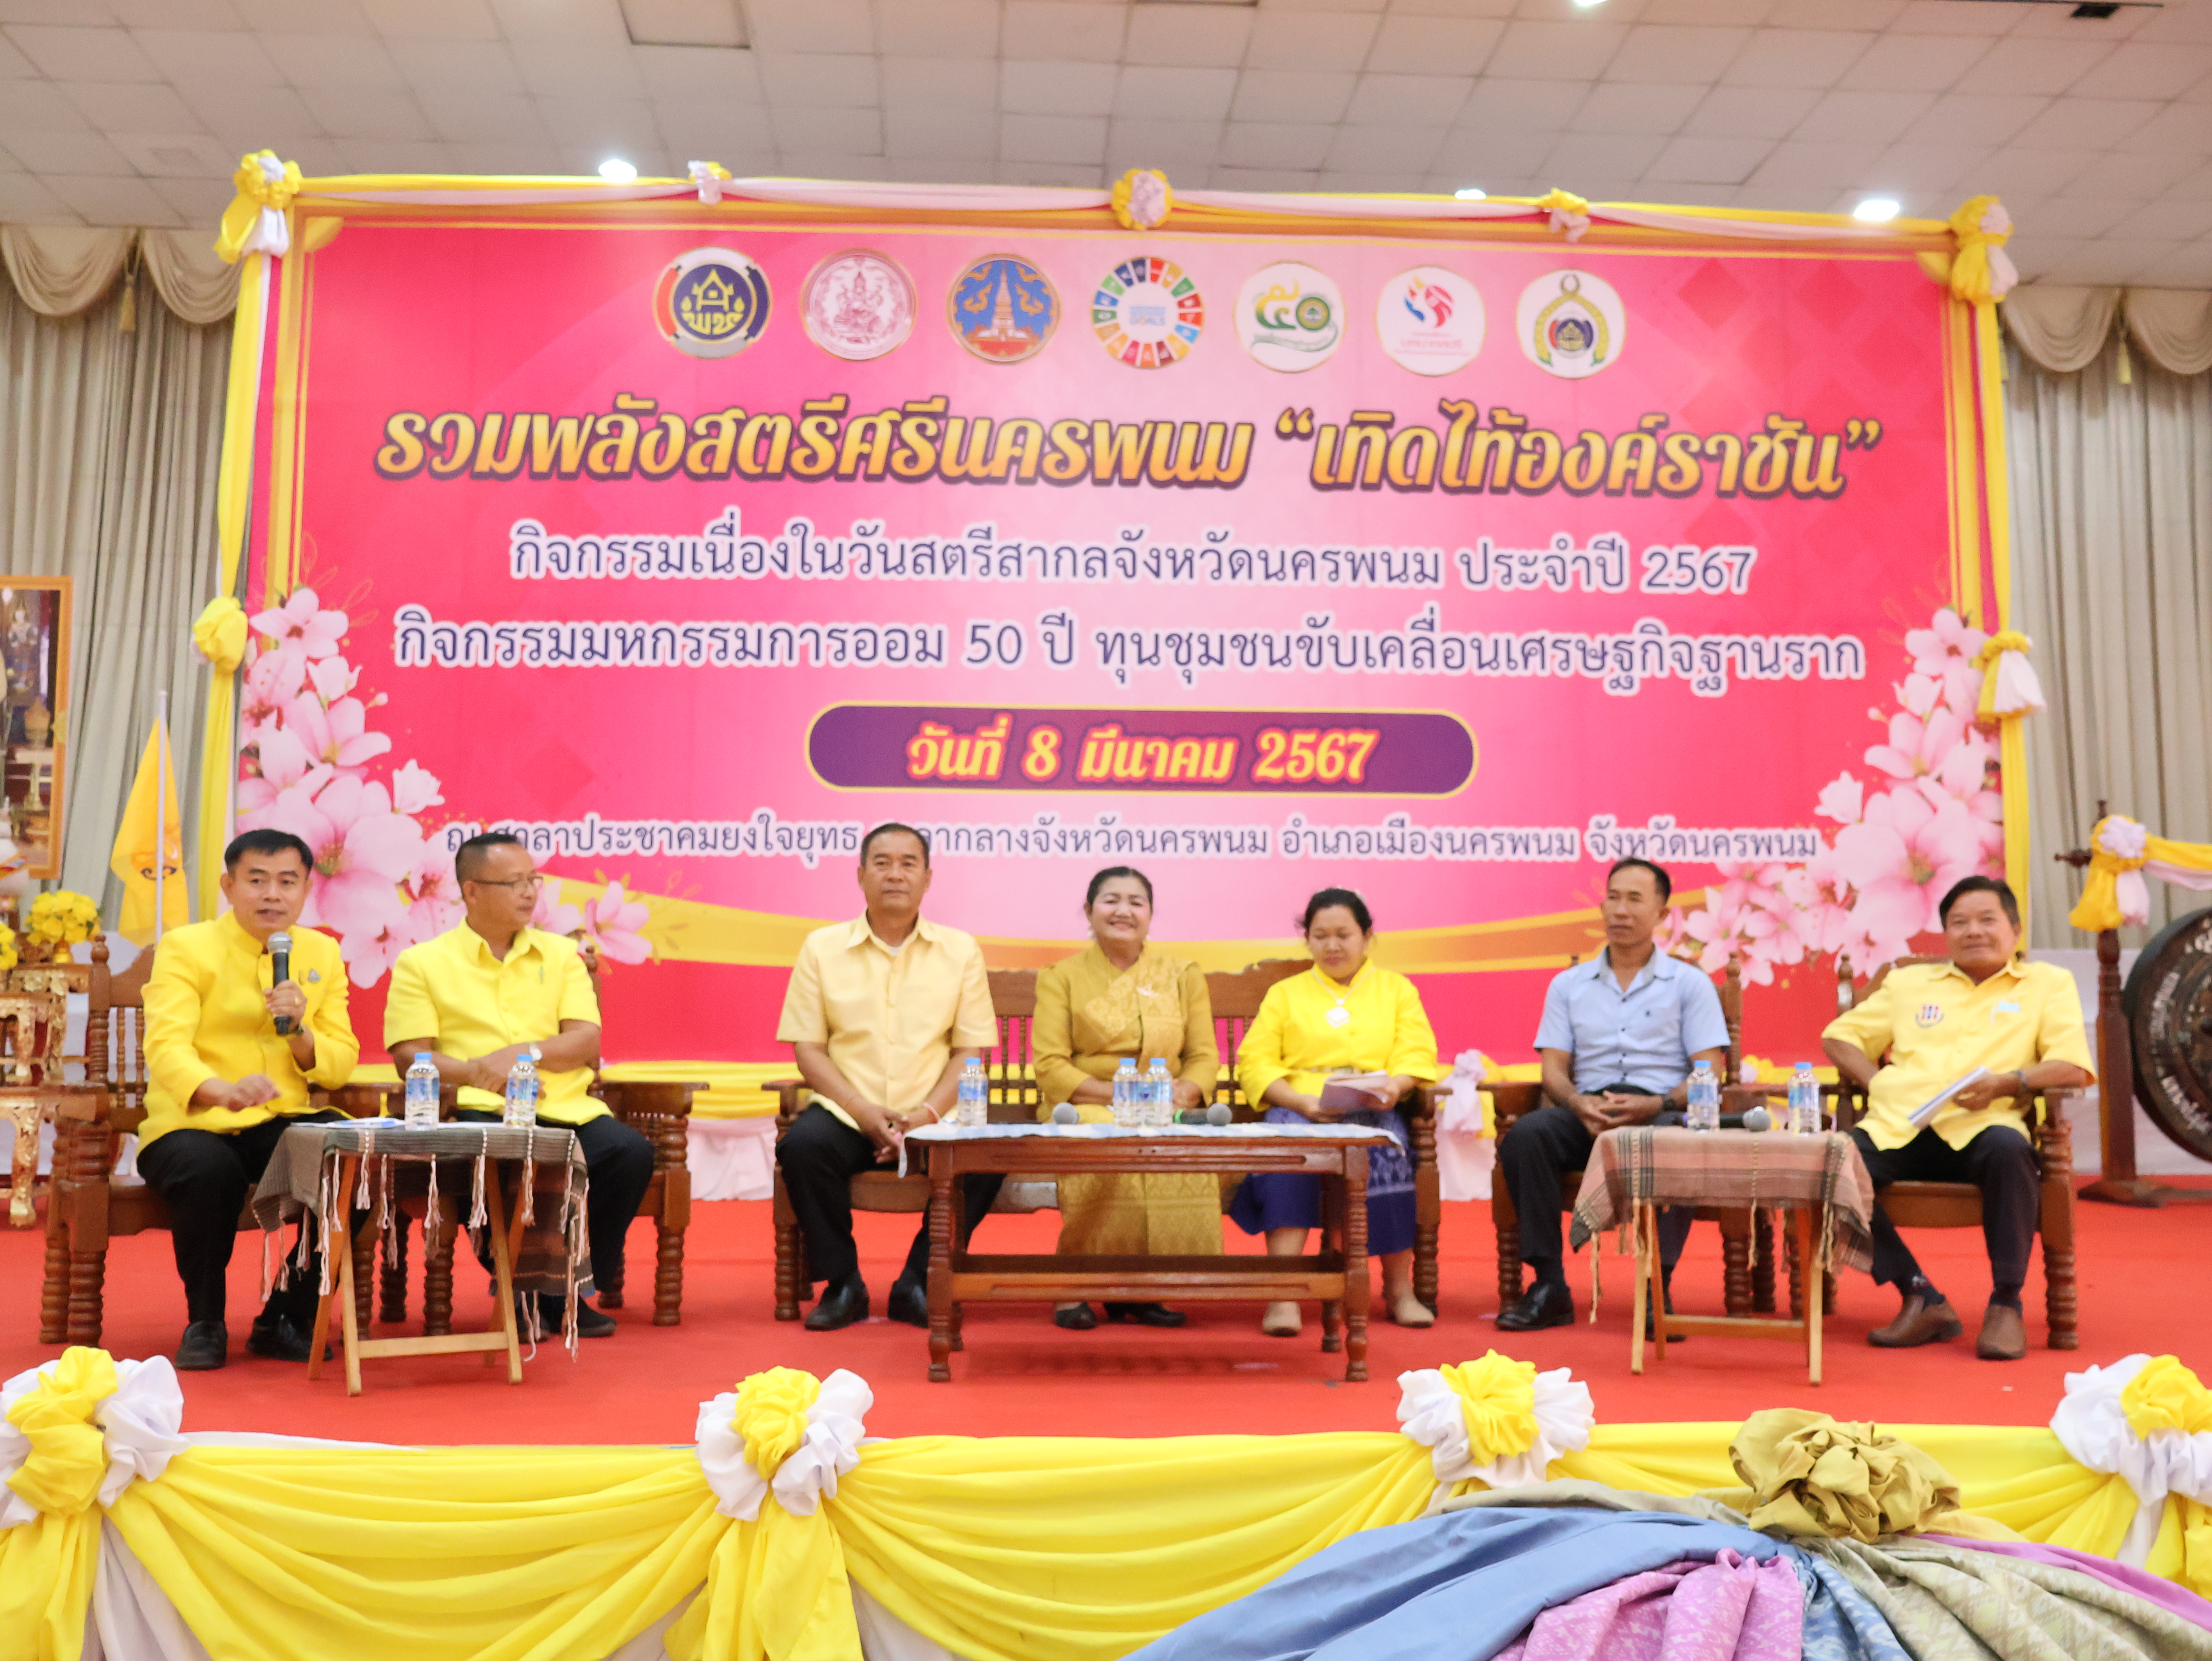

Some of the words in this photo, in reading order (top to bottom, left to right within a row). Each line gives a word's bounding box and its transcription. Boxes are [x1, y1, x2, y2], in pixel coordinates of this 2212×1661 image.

[374, 392, 1254, 489] รวมพลังสตรีศรีนครพนม
[515, 511, 1439, 583] กิจกรรมเนื่องในวันสตรีสากลจังหวัดนครพนม
[1459, 537, 1624, 587] ประจำปี
[1646, 551, 1753, 588] 2567
[399, 608, 943, 664] กิจกรรมมหกรรมการออม
[966, 624, 1023, 665] 50
[1040, 611, 1074, 665] ปี
[1096, 606, 1860, 691] ทุนชุมชนขับเคลื่อนเศรษฐกิจฐานราก
[910, 717, 1009, 776] วันที่
[1025, 729, 1058, 777] 8
[1080, 728, 1235, 778] มีนาคม
[1255, 732, 1376, 779] 2567
[494, 814, 858, 863] าลาประชาคมยงใจยุทธ
[1282, 819, 1576, 856] อำเภอเมืองนครพนม
[1590, 821, 1816, 857] จังหวัดนครพนม
